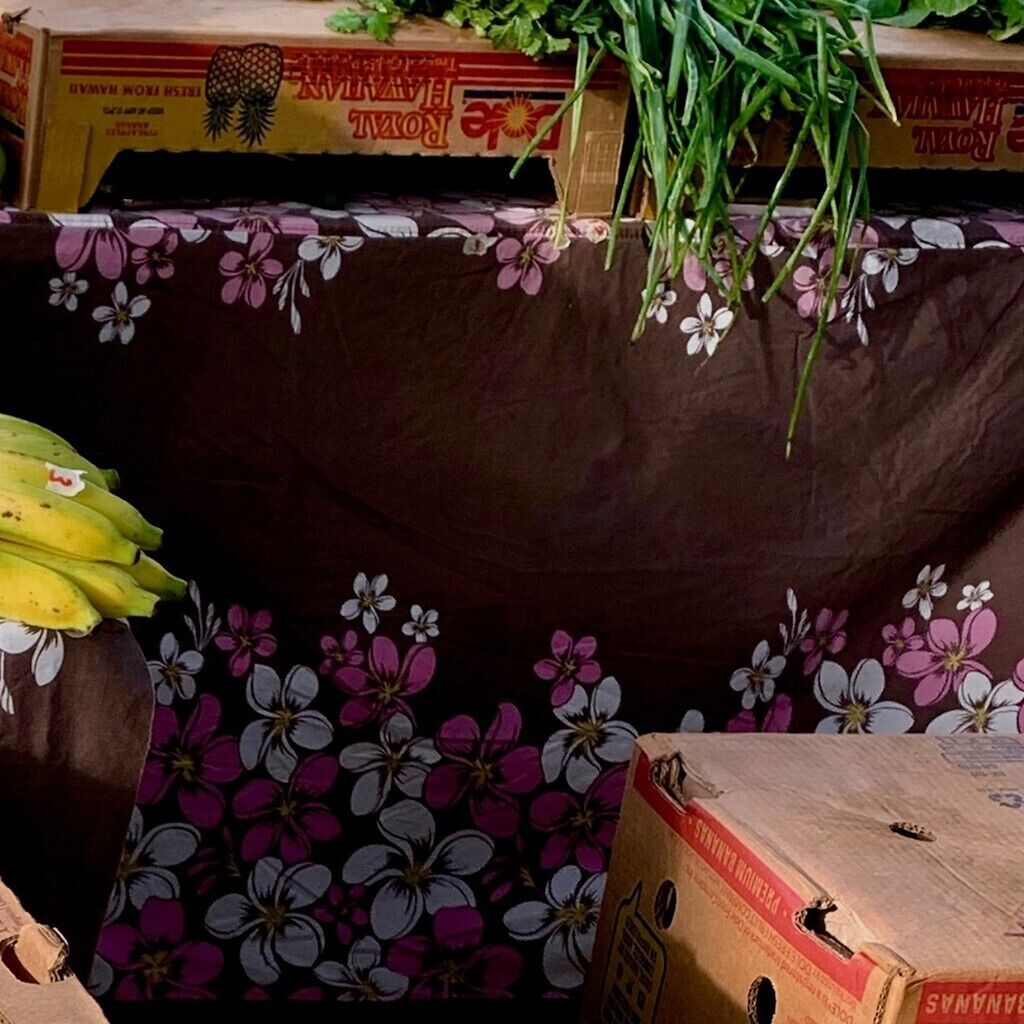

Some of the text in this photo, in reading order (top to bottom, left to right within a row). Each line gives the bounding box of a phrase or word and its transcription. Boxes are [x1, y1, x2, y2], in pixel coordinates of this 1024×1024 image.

[69, 83, 202, 97] FRESH FROM HAWAII
[349, 109, 452, 150] ROYAL
[460, 98, 562, 150] Dole
[912, 126, 998, 163] ROYAL
[694, 818, 735, 873] BANANAS
[734, 858, 781, 916] PREMIUM
[925, 993, 1024, 1015] BANANAS
